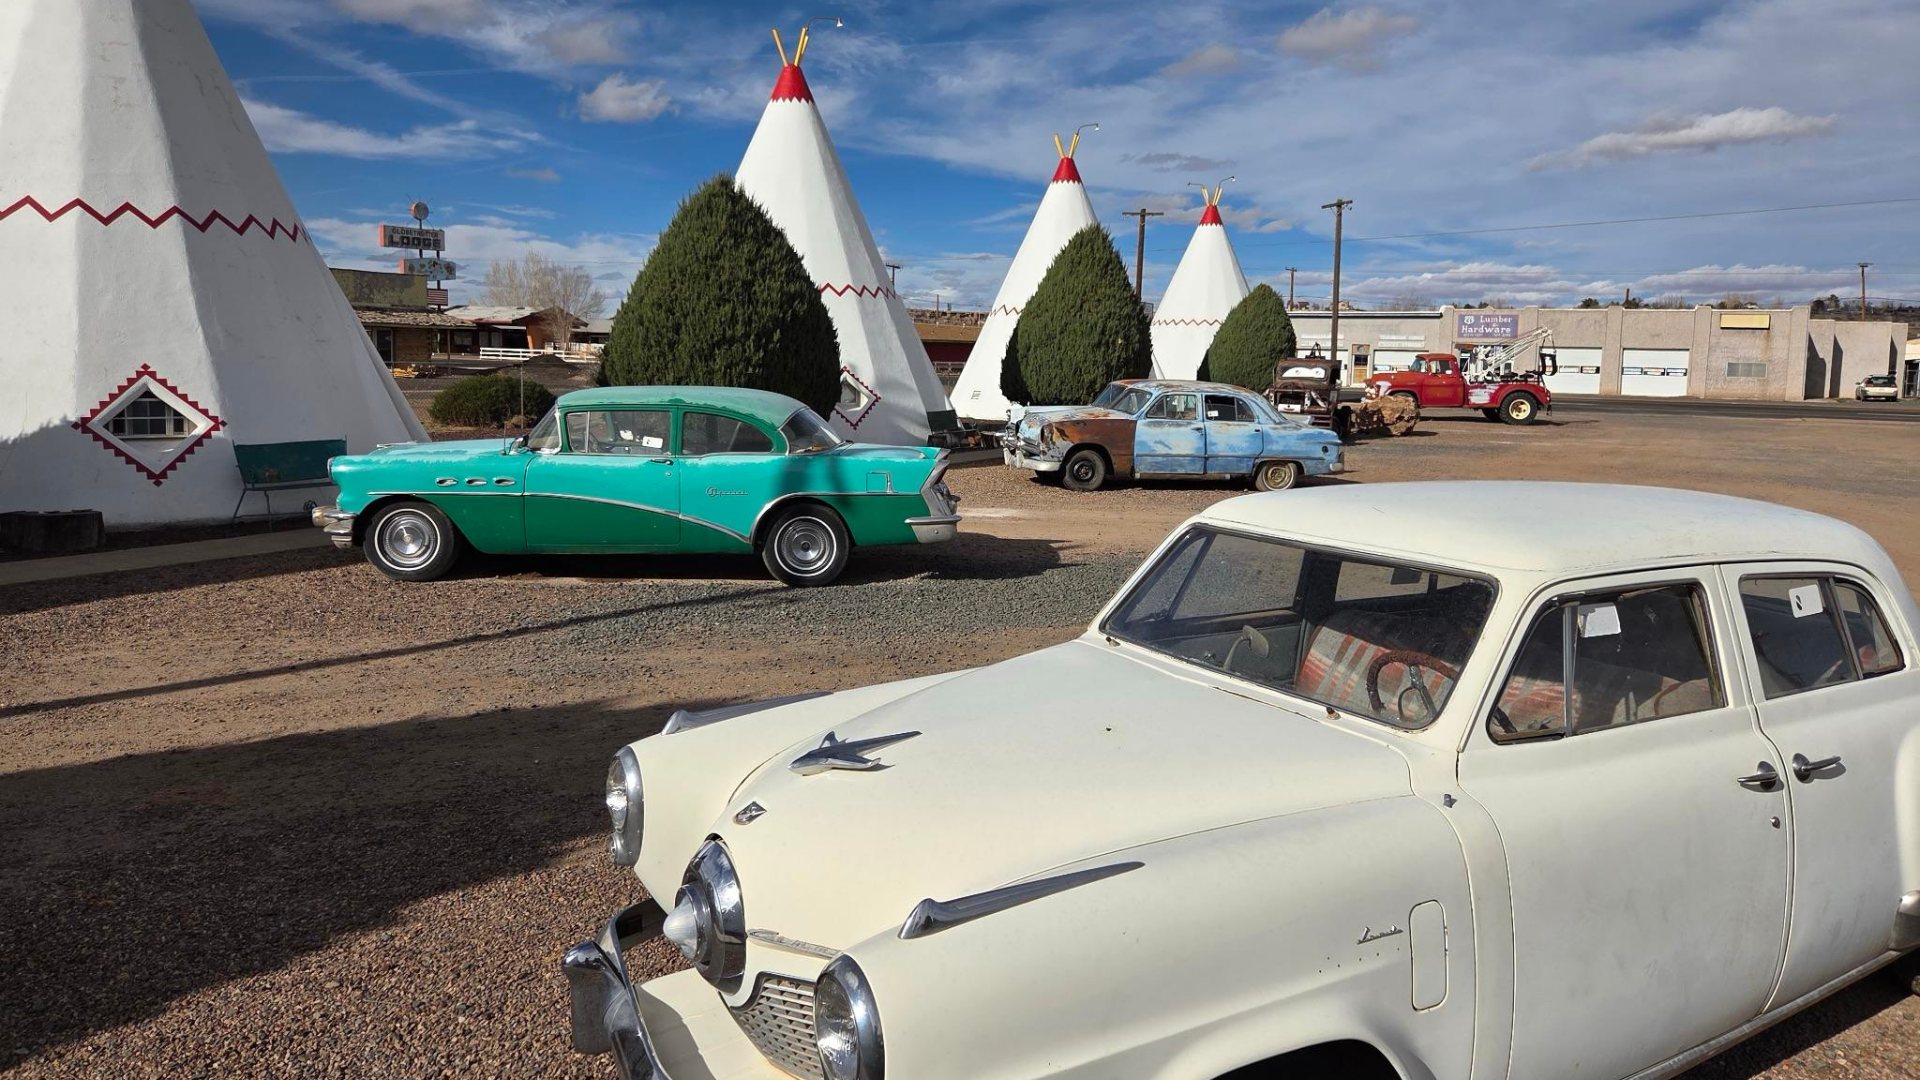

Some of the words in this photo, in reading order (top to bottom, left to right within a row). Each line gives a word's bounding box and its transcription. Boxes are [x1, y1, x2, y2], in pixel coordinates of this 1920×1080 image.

[388, 234, 441, 248] LODGE
[1480, 315, 1512, 323] Lumber
[1461, 325, 1511, 333] Hardware
